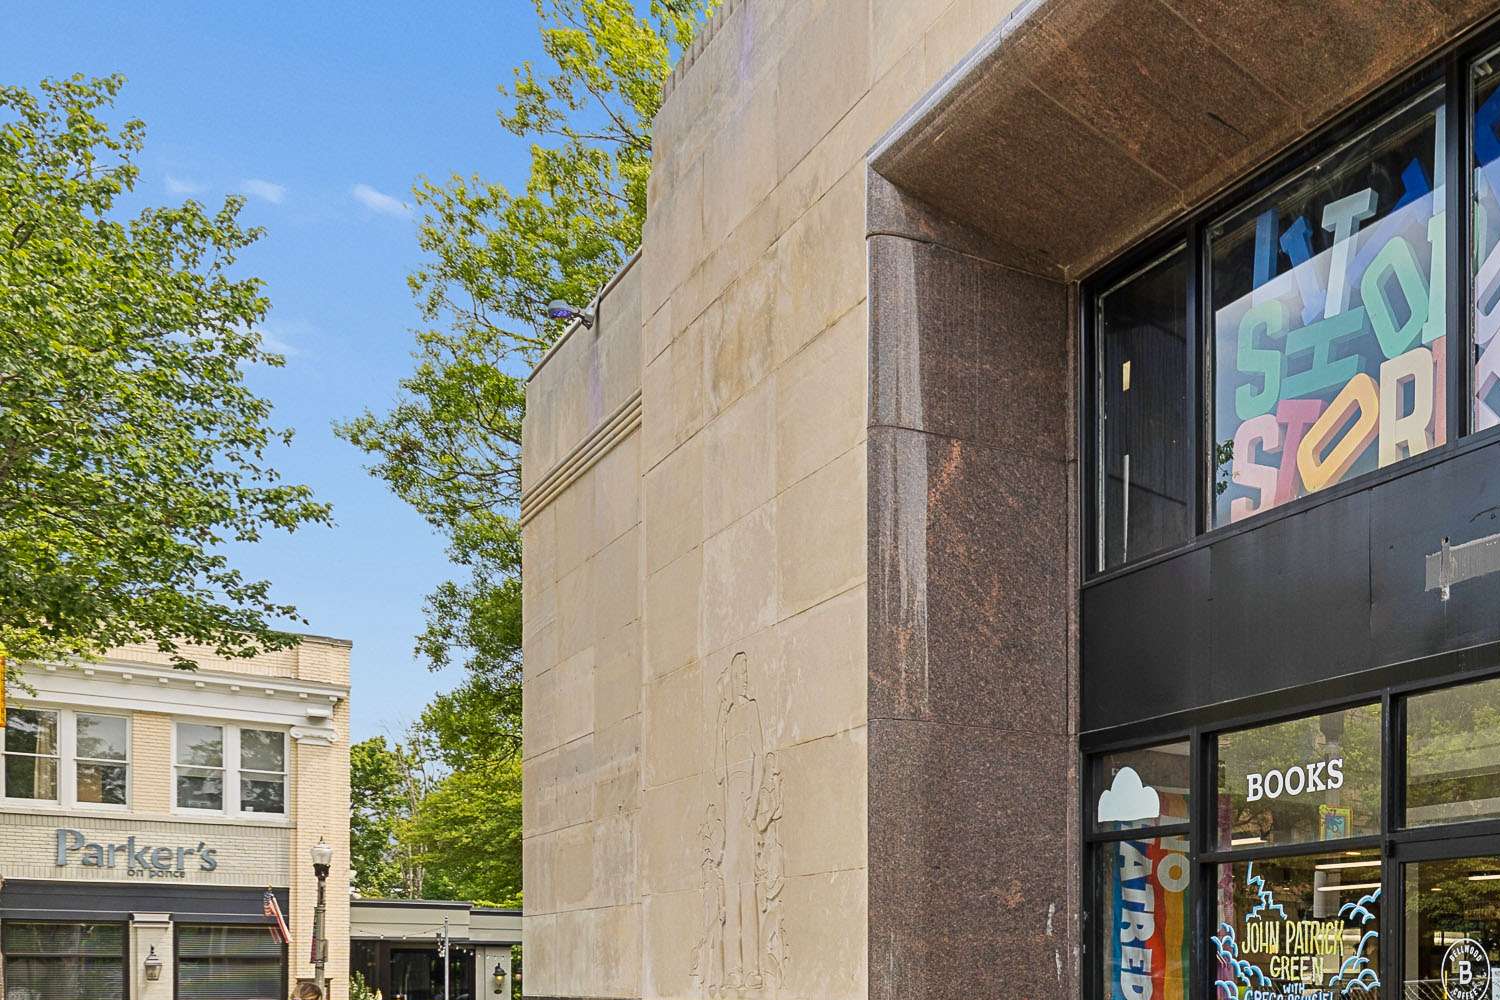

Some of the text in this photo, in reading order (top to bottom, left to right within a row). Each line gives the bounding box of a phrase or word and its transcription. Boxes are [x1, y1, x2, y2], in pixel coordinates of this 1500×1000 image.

[1246, 758, 1344, 802] BOOKS
[55, 828, 218, 872] Parker's
[1242, 920, 1345, 957] JOHN PATRICK
[1449, 943, 1483, 962] BELLWOOD
[1269, 955, 1324, 985] GREEN
[1458, 960, 1473, 985] B
[1282, 983, 1305, 995] WITH
[1452, 986, 1479, 1000] COFFEE
